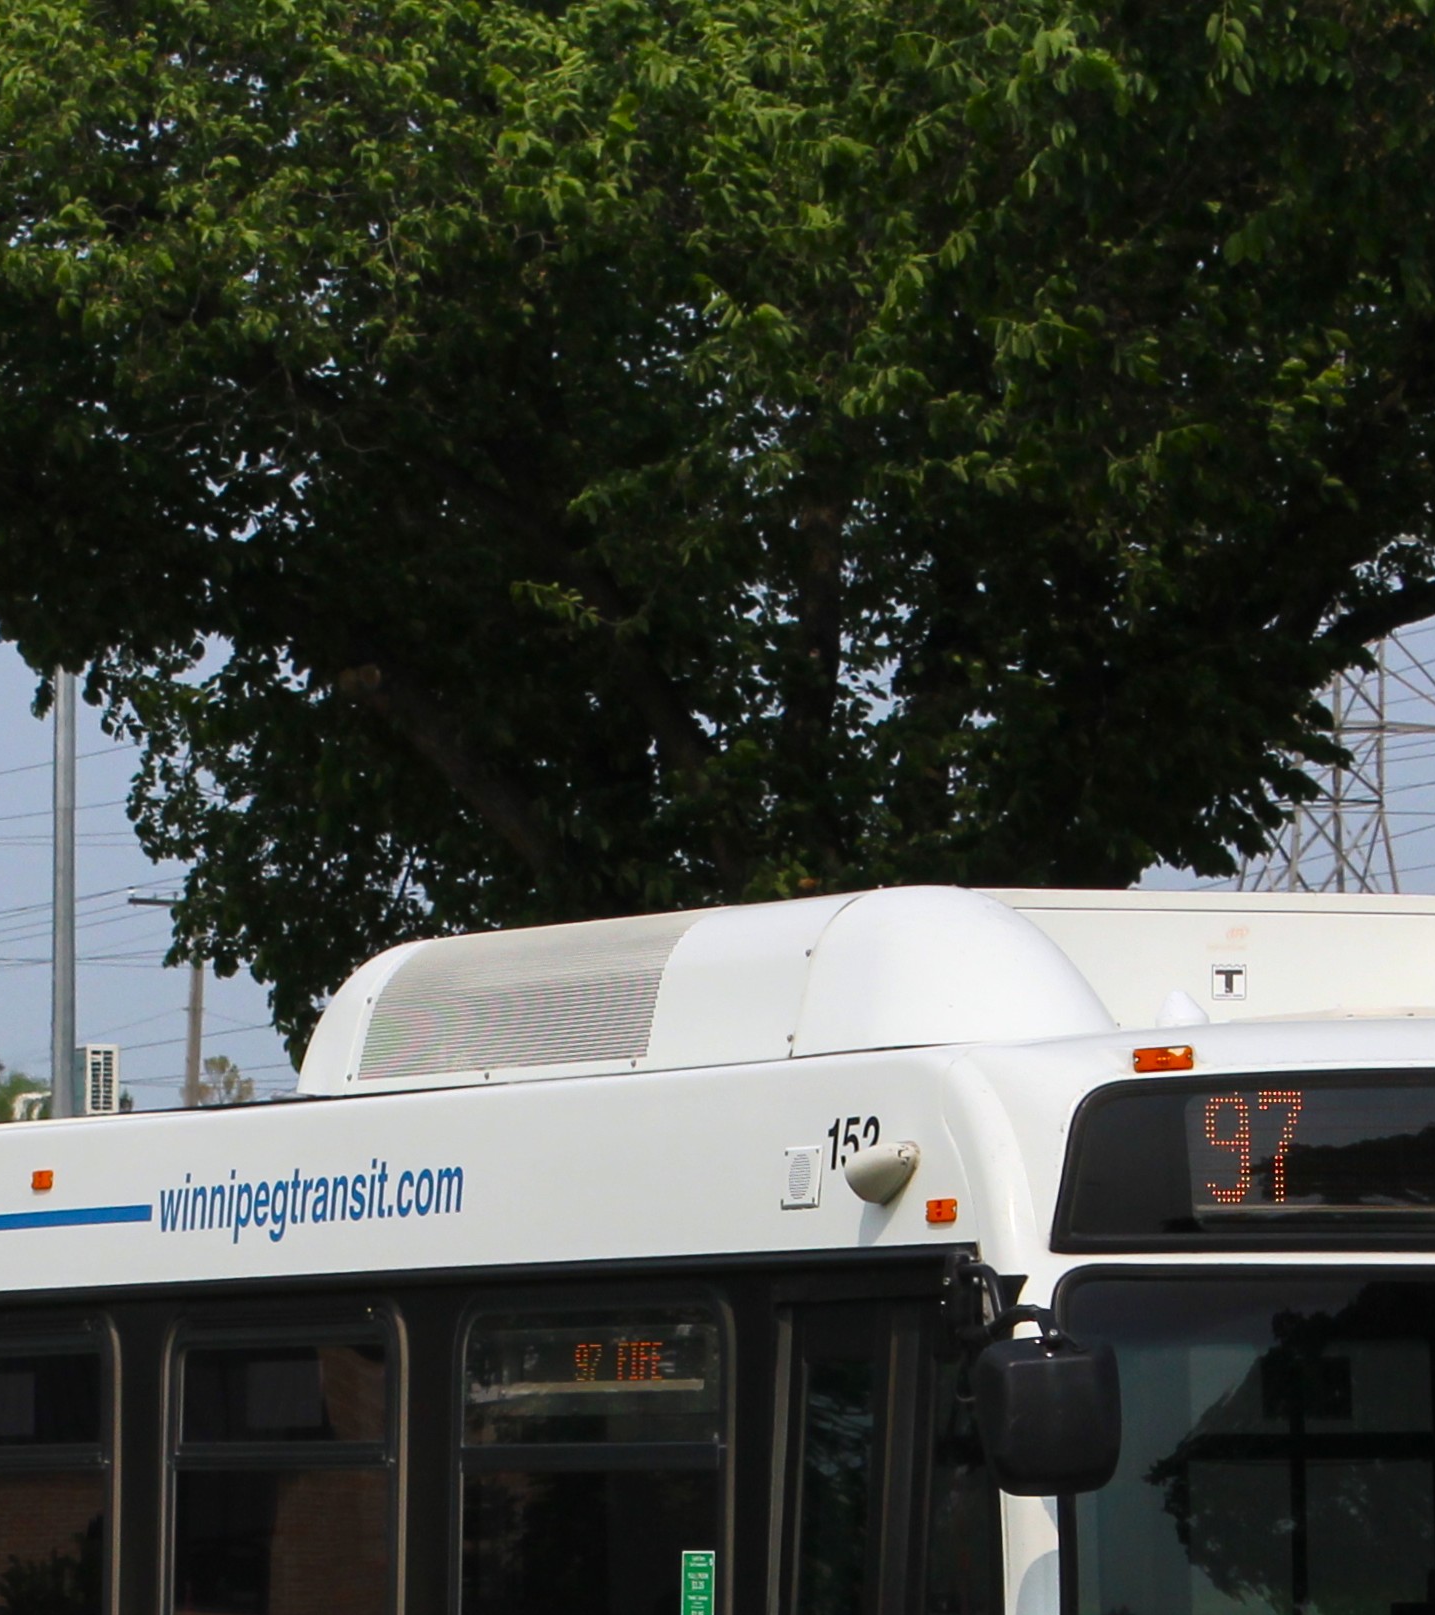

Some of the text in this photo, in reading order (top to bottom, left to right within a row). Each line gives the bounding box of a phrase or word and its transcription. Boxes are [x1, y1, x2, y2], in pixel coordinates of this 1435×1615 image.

[828, 1115, 881, 1171] 152
[1205, 1090, 1302, 1204] 97
[159, 1158, 464, 1244] winnipegtransit.com
[575, 1342, 663, 1381] 97 FIFE
